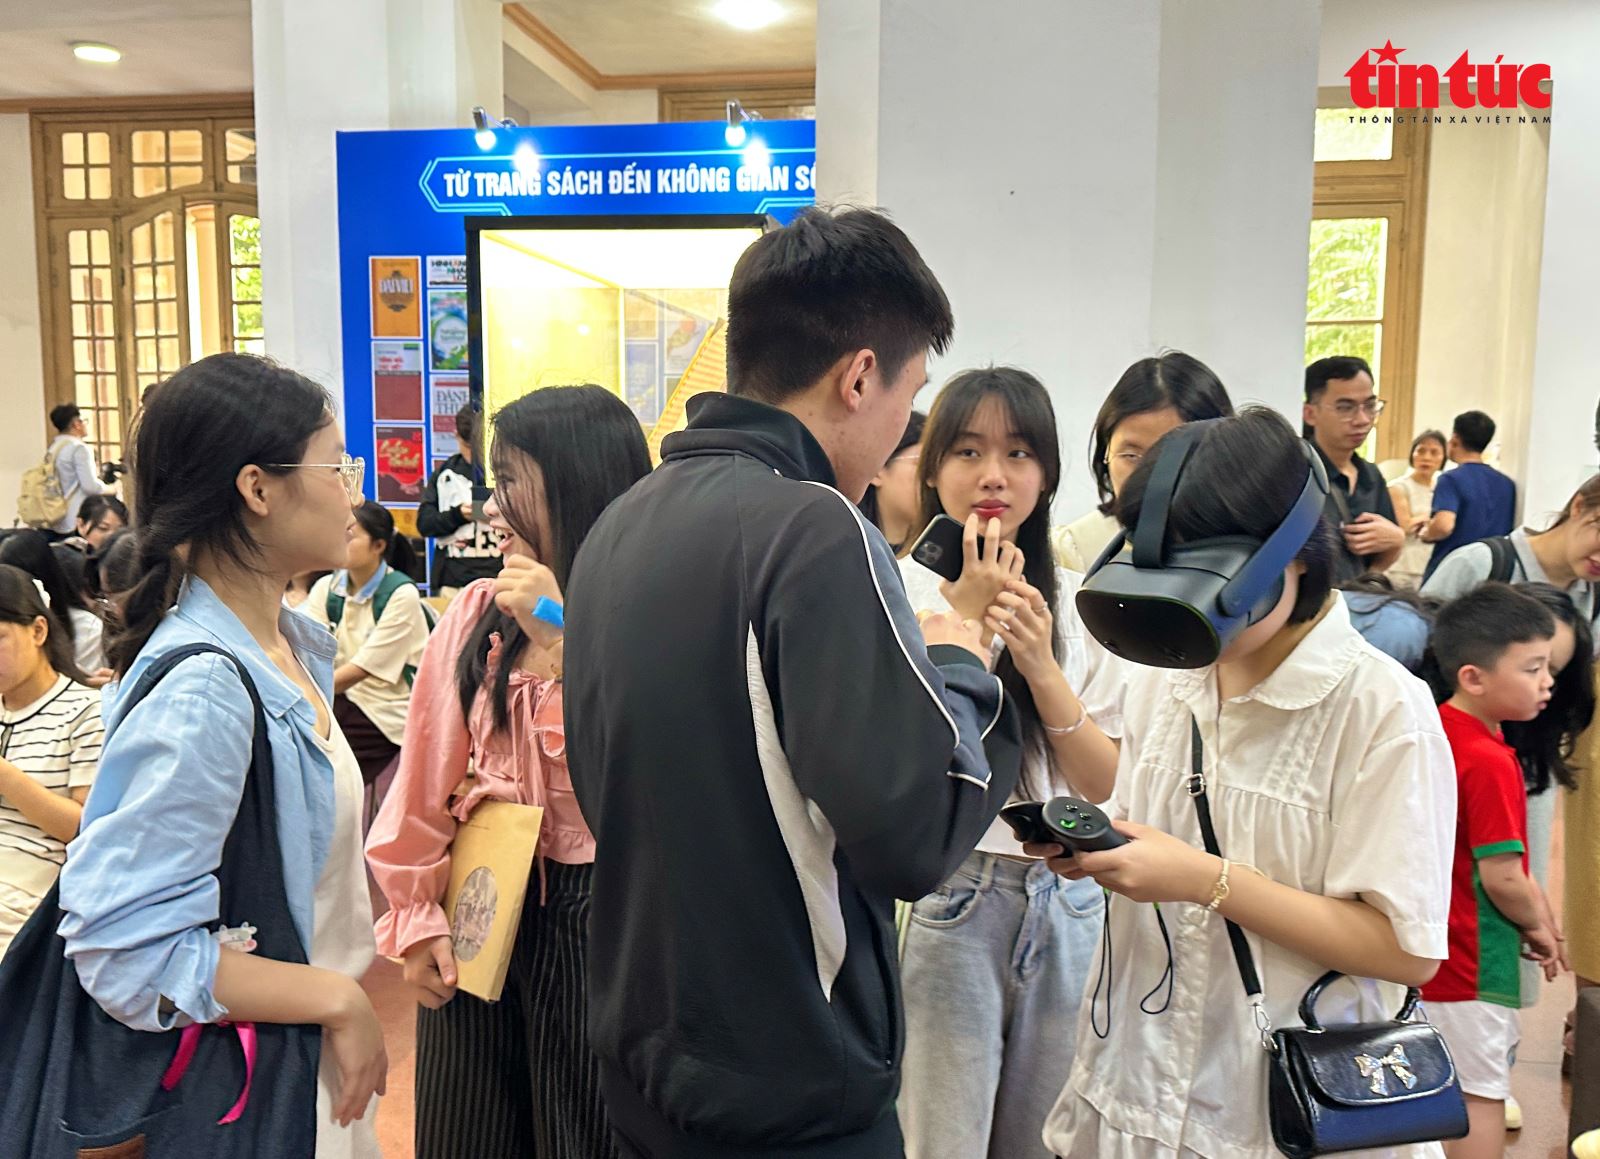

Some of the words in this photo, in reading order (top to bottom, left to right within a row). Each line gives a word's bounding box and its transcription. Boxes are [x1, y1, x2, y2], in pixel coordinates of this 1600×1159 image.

[444, 168, 471, 198] TỪ
[474, 170, 541, 197] TRANG
[547, 165, 603, 196] SÁCH
[608, 162, 651, 195] ĐẾN
[656, 162, 731, 194] KHÔNG
[736, 167, 789, 193] GIAN
